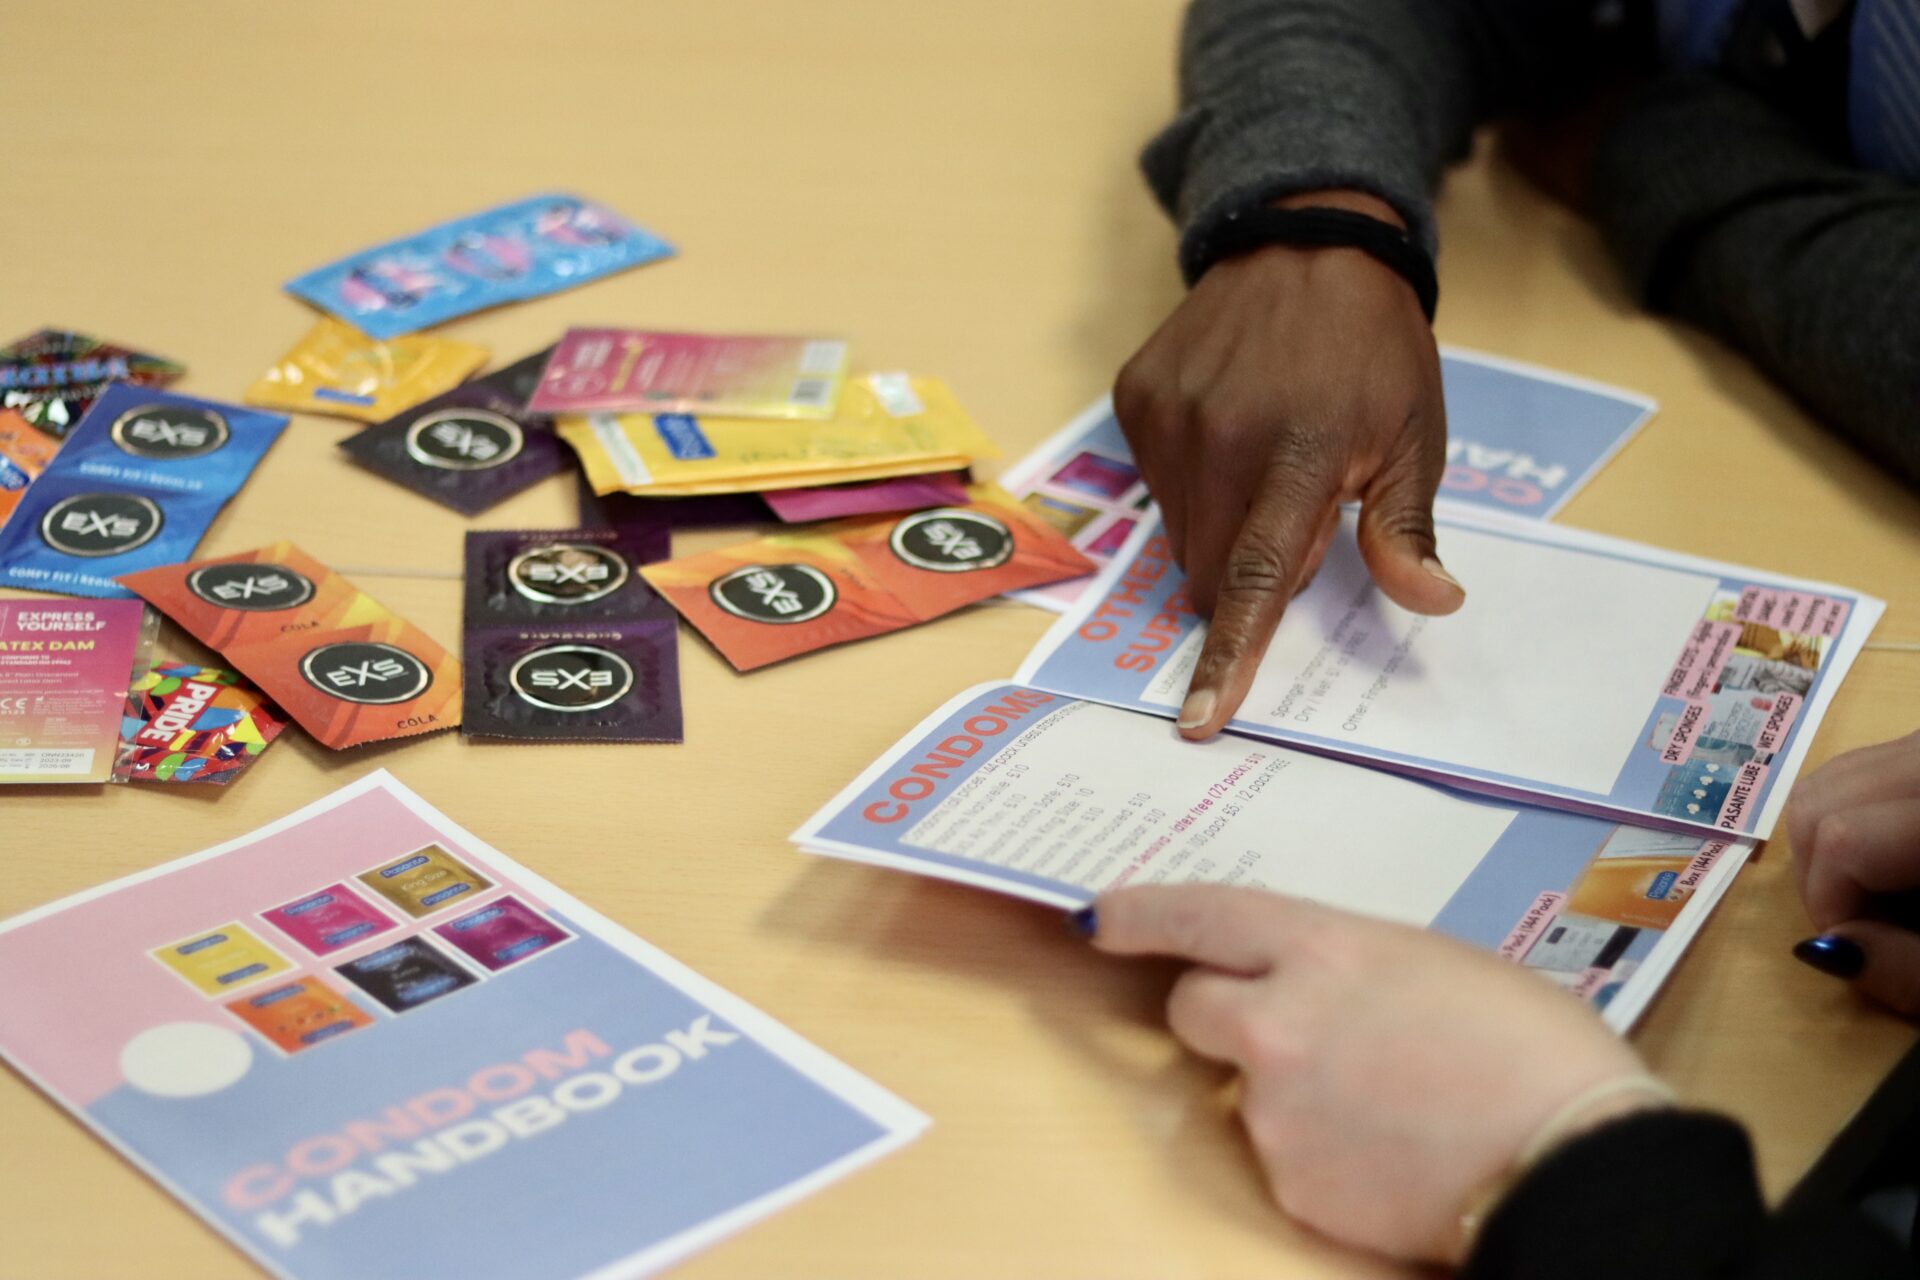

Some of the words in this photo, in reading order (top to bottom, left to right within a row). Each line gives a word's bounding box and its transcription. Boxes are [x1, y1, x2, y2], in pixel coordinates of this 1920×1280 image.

[61, 510, 141, 538] EXS
[211, 573, 290, 600] EXS
[16, 620, 107, 632] YOURSELF
[18, 611, 95, 621] EXPRESS
[49, 640, 96, 651] DAM
[326, 658, 405, 687] EXS
[531, 668, 613, 690] EXS
[140, 682, 216, 743] PRIDE
[397, 713, 438, 729] COLA
[1766, 695, 1794, 733] SPONGES
[1664, 743, 1681, 761] DRY
[1673, 705, 1703, 743] SPONGES
[1758, 728, 1775, 749] WET
[863, 688, 1056, 824] CONDOMS
[1170, 812, 1197, 834] latex
[1190, 798, 1214, 816] free
[1208, 783, 1228, 800] (72
[1204, 815, 1230, 840] pack
[1234, 789, 1254, 803] 12
[1248, 772, 1273, 794] pack
[1265, 757, 1291, 774] FREE
[1721, 785, 1751, 830] PASANTE
[1740, 764, 1761, 787] LUBE
[382, 856, 427, 878] Pasante
[1680, 872, 1702, 886] Box
[1531, 893, 1562, 916] Pack)
[222, 1028, 613, 1213] CONDOM
[255, 1015, 740, 1249] HANDBOOK
